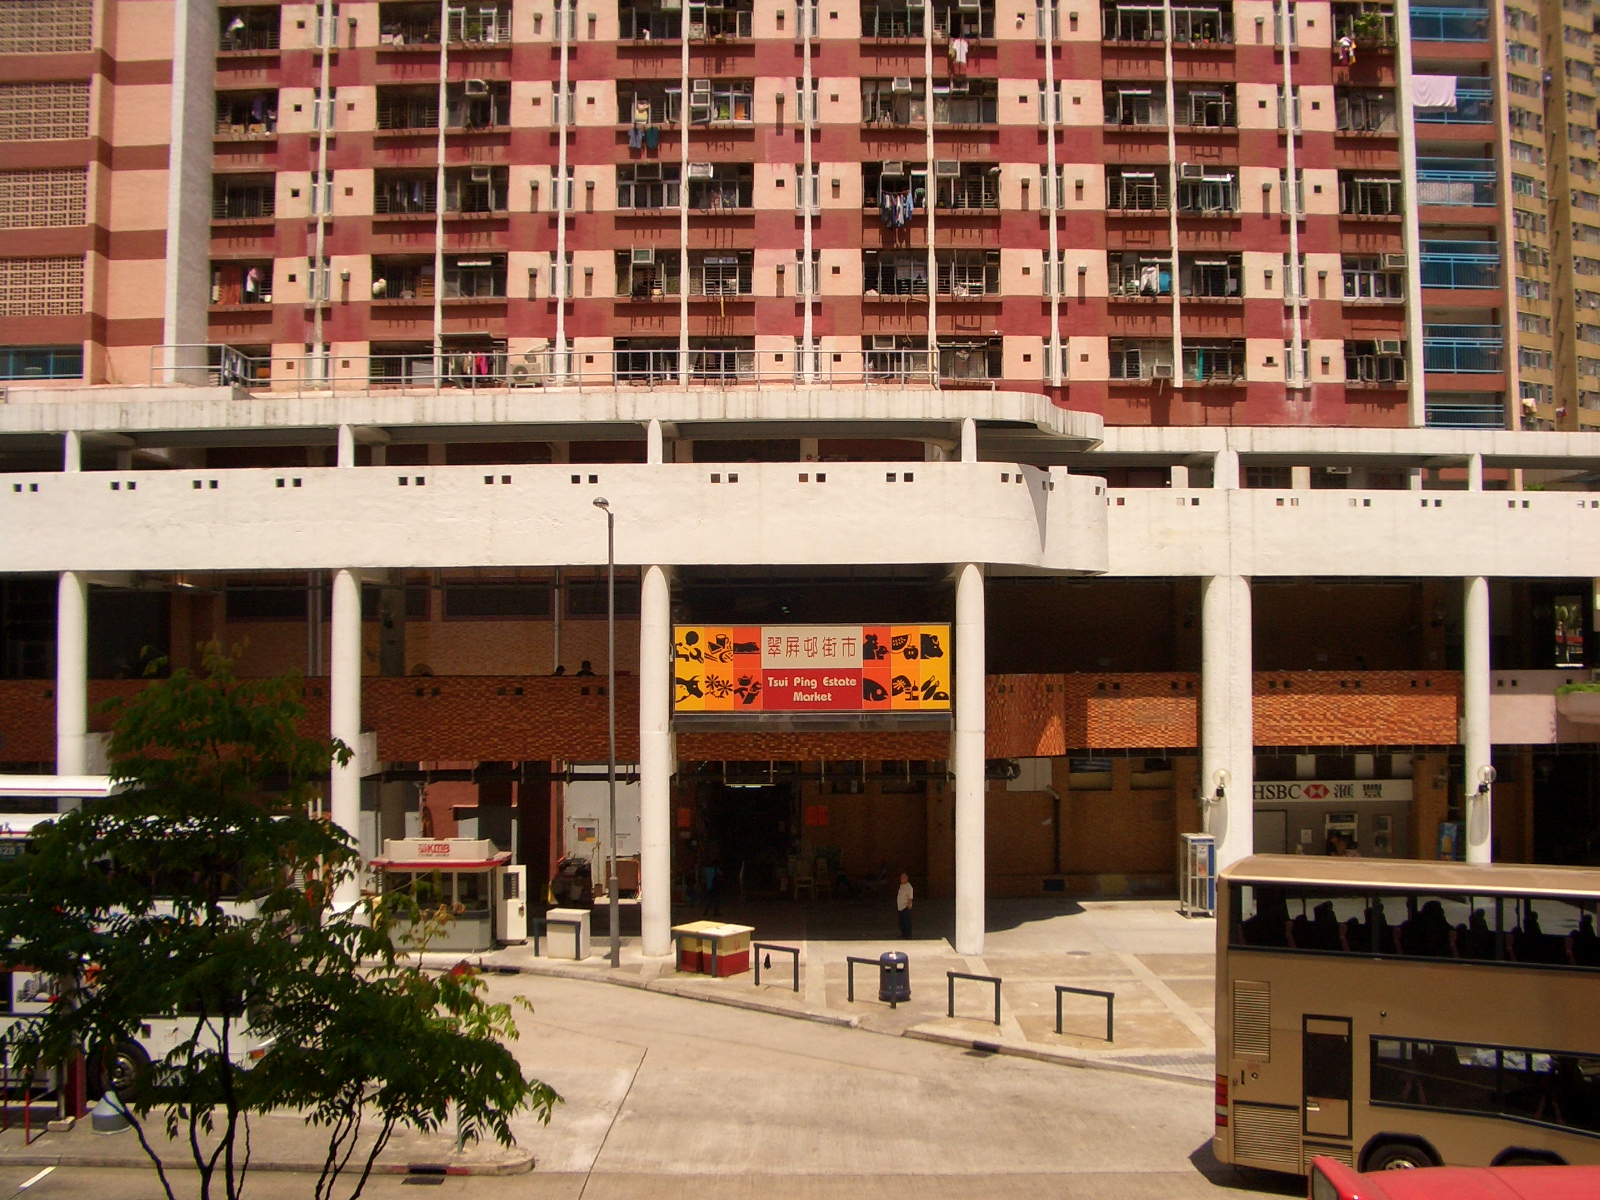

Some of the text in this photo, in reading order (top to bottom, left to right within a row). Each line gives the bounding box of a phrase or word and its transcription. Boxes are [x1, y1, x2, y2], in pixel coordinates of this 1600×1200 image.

[767, 636, 857, 658] 翠屏邨街市
[767, 676, 858, 690] Tsui Ping Estate
[793, 691, 833, 702] Market
[1253, 784, 1302, 800] HSBC
